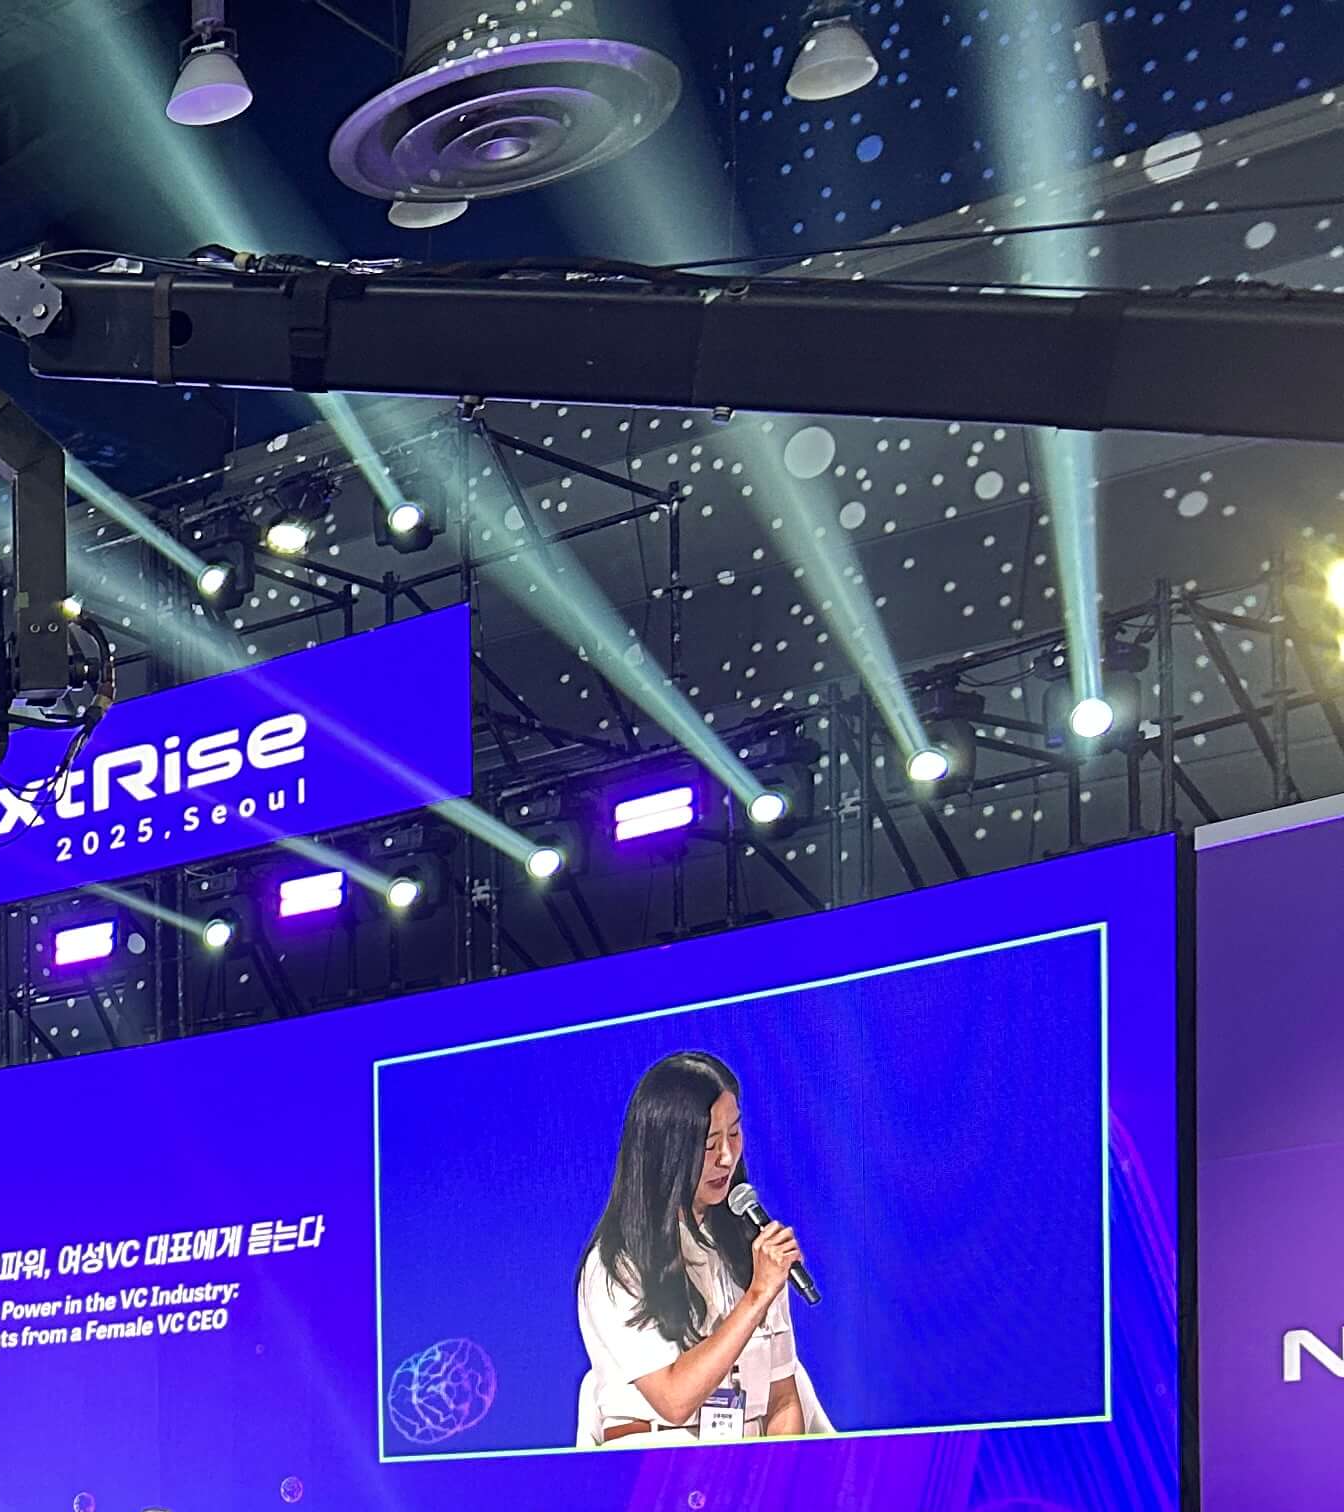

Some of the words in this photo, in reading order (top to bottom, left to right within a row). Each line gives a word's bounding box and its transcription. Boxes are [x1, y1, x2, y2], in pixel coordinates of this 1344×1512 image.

[57, 1239, 141, 1275] 여성VC
[144, 1224, 243, 1266] 대표에게
[248, 1214, 326, 1256] 듣는다
[1, 1300, 62, 1321] Power
[64, 1294, 82, 1315] in
[85, 1291, 117, 1313] the
[119, 1287, 149, 1310] VC
[150, 1282, 240, 1307] Industry:
[21, 1326, 68, 1347] from
[69, 1326, 82, 1343] a
[85, 1316, 154, 1342] Female
[157, 1311, 185, 1335] VC
[186, 1307, 229, 1332] CEO
